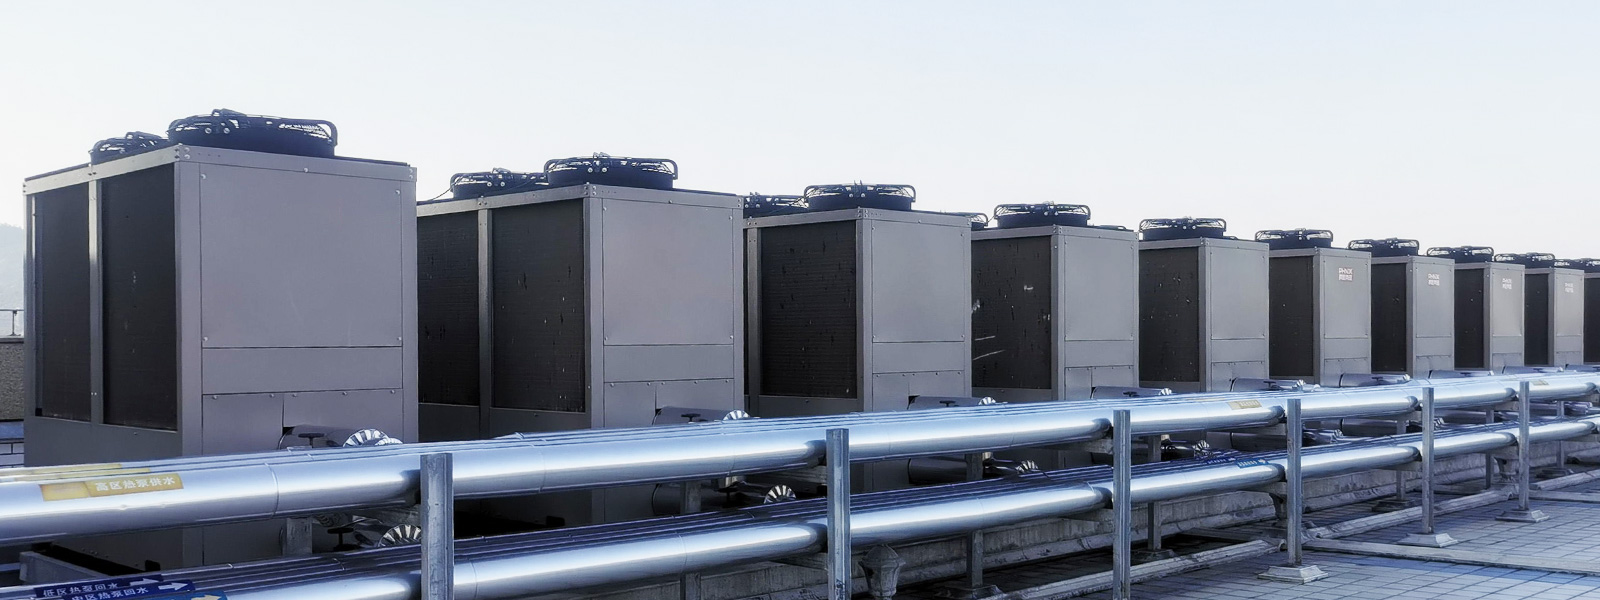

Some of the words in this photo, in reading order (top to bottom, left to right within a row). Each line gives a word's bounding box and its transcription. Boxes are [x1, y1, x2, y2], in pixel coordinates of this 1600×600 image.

[95, 476, 175, 491] 高区热泵供水
